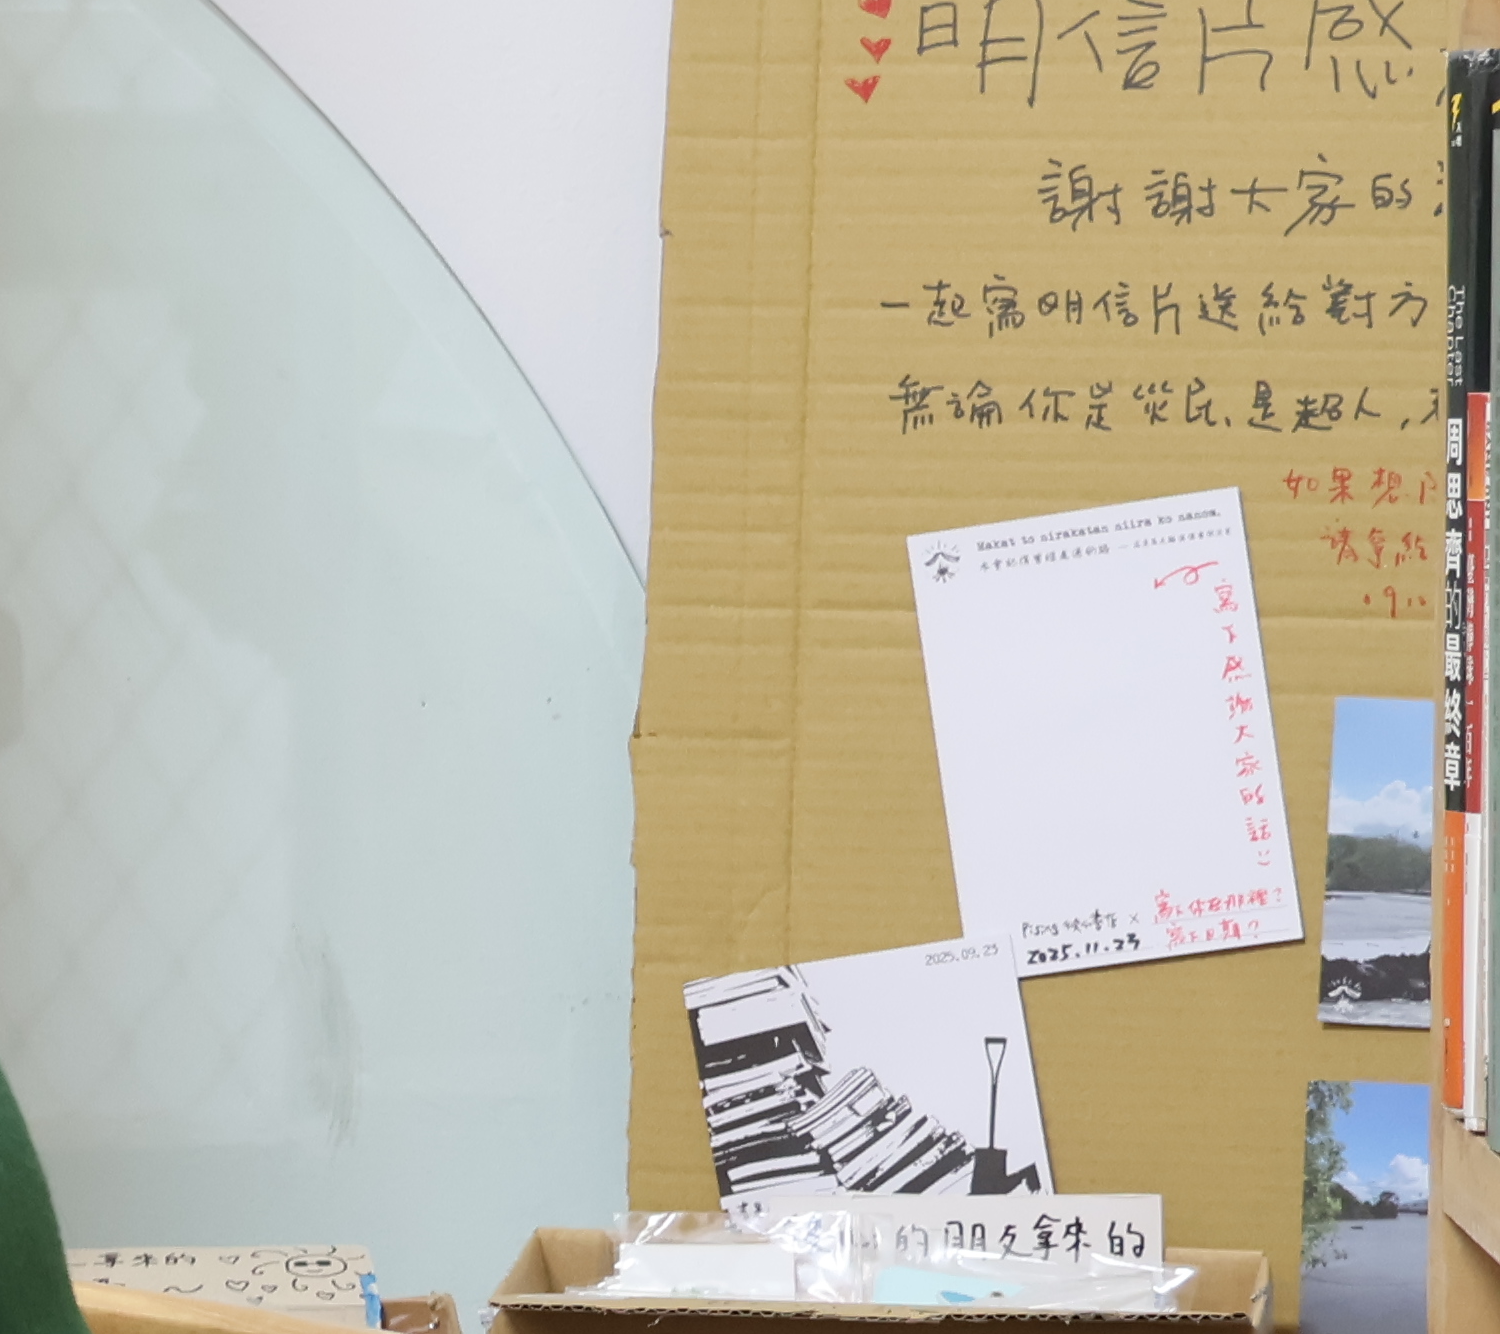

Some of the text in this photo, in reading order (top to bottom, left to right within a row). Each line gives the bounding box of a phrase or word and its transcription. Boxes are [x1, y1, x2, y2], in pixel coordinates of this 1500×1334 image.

[1443, 417, 1465, 791] 周思齊的最終章
